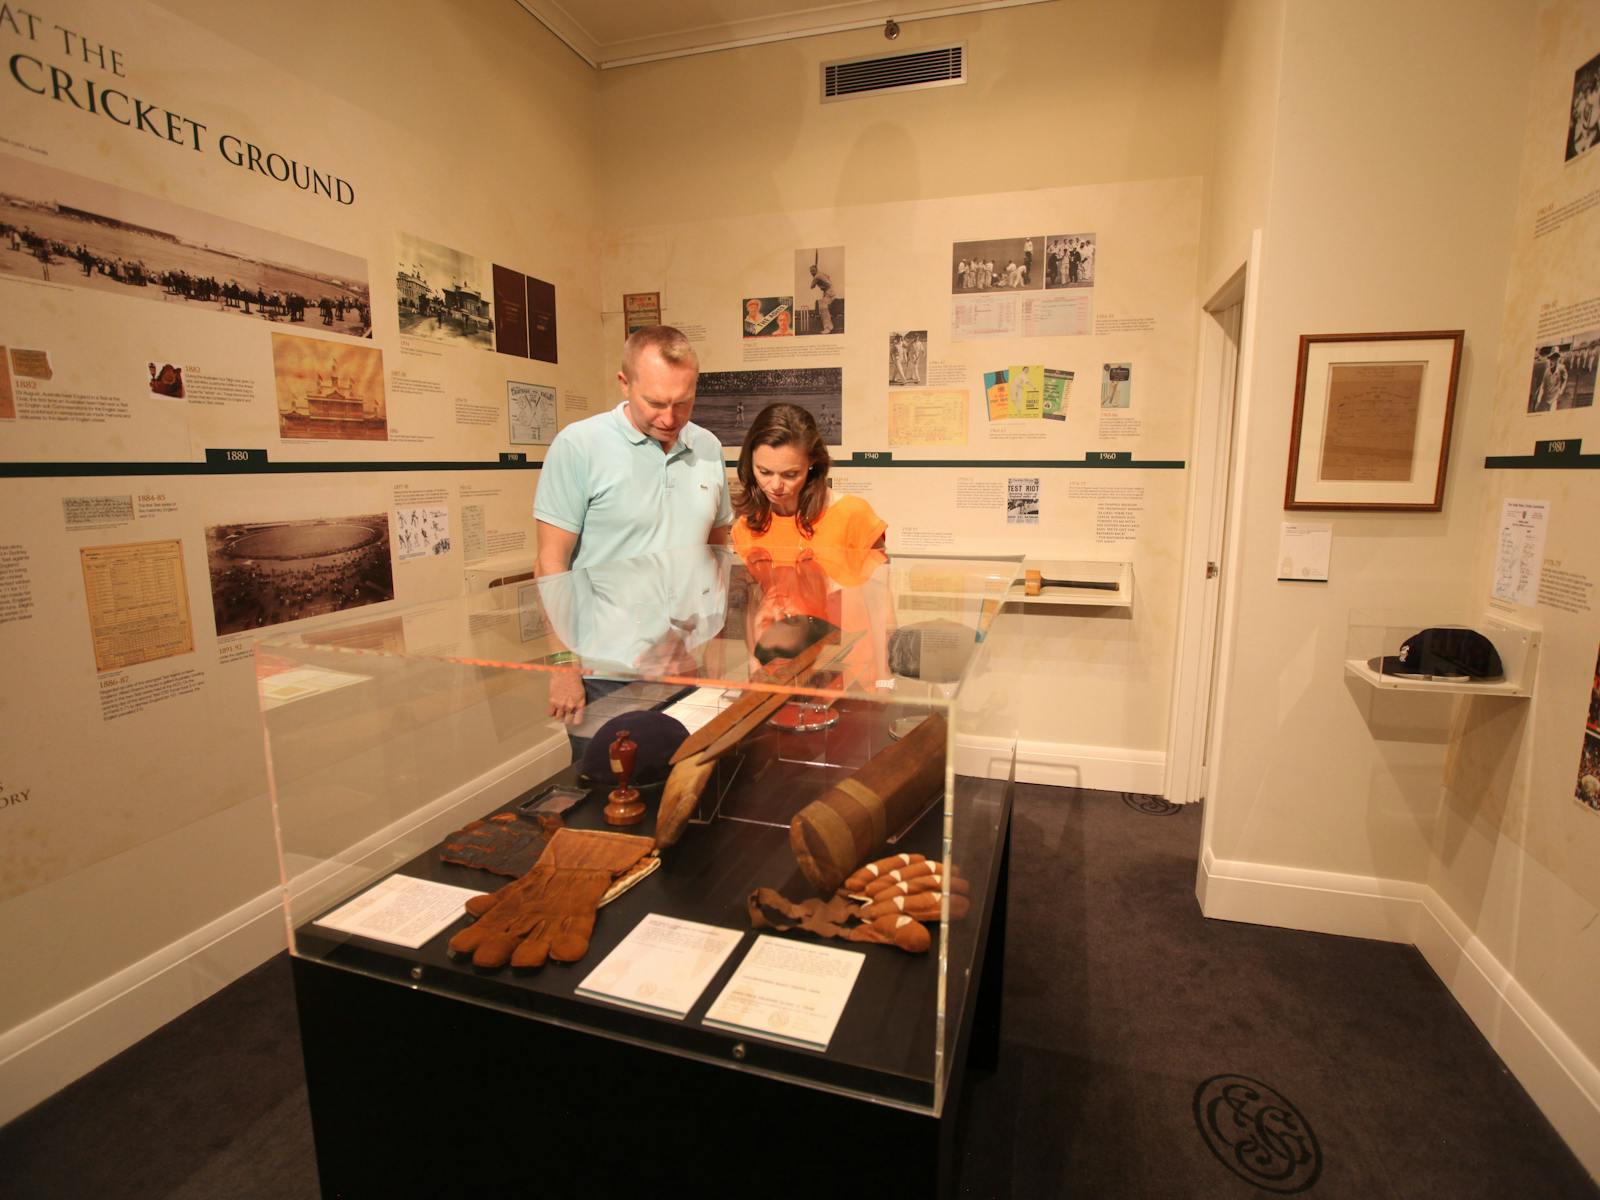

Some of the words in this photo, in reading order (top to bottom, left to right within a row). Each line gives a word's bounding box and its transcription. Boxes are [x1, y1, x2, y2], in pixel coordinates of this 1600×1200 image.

[0, 3, 42, 40] AT
[54, 25, 126, 78] THE
[9, 53, 207, 153] CRICKET
[219, 134, 355, 206] GROUND
[1548, 440, 1566, 453] 1980
[226, 450, 249, 461] 1880
[864, 451, 879, 460] 1940
[1099, 452, 1117, 460] 1960
